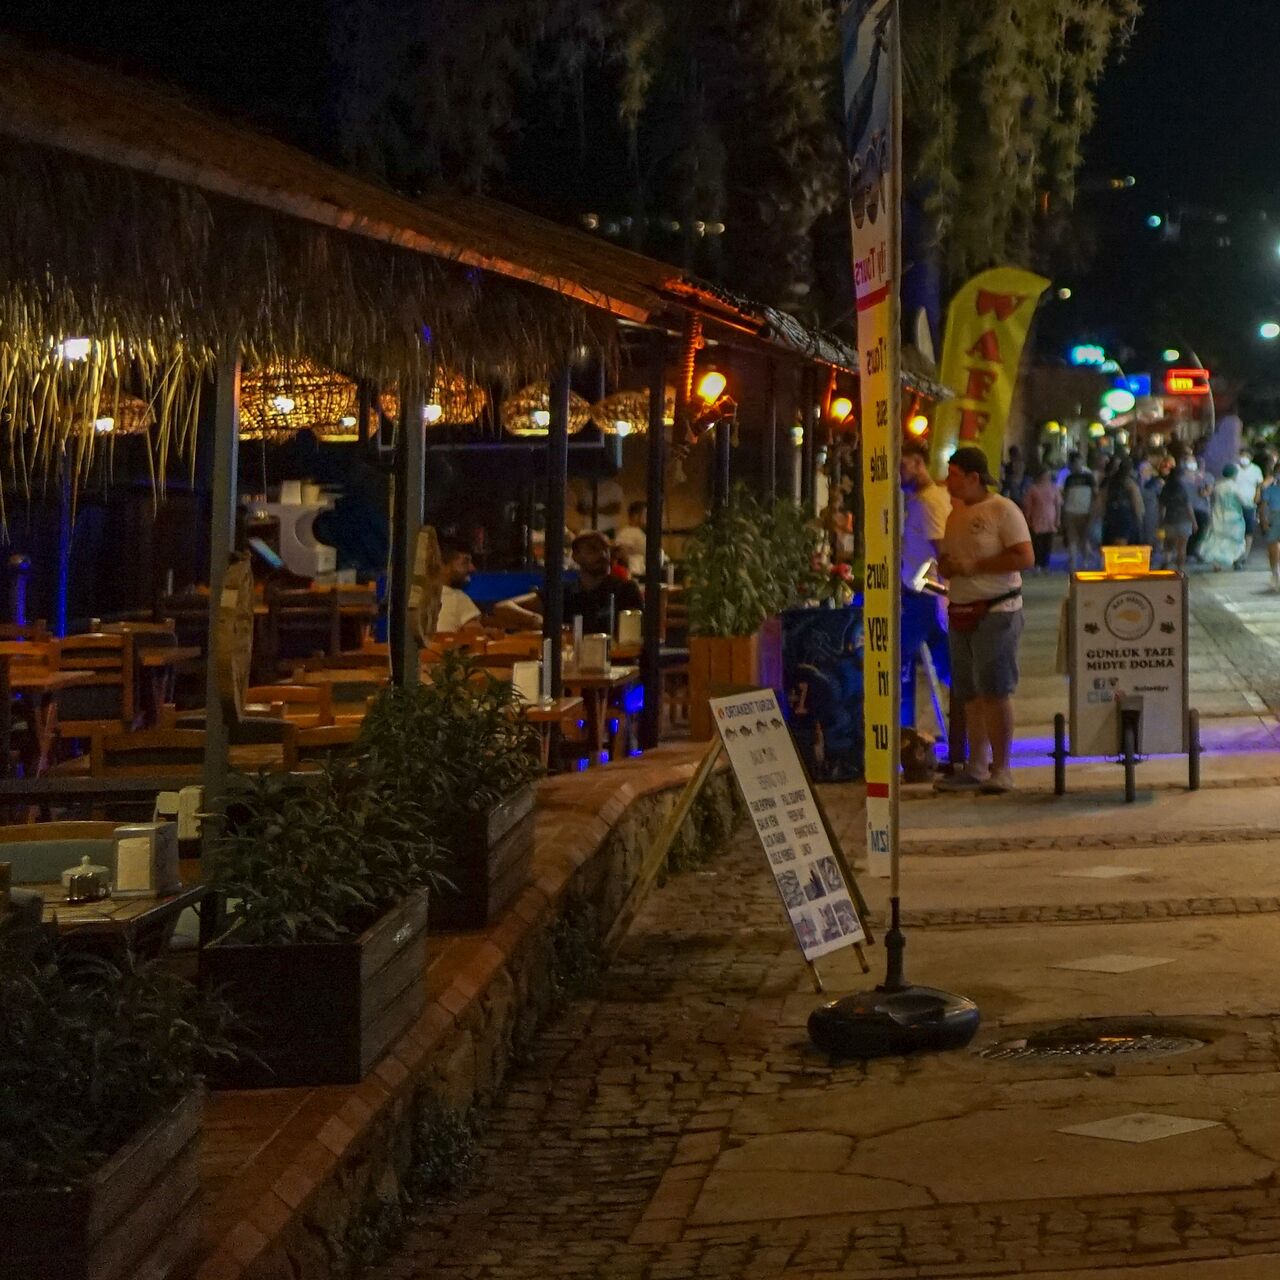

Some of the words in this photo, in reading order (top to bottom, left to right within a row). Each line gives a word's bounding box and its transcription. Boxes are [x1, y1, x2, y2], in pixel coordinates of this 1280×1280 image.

[959, 288, 1029, 442] WAFF
[1144, 646, 1176, 658] TAZE
[1130, 658, 1175, 670] DOLMA
